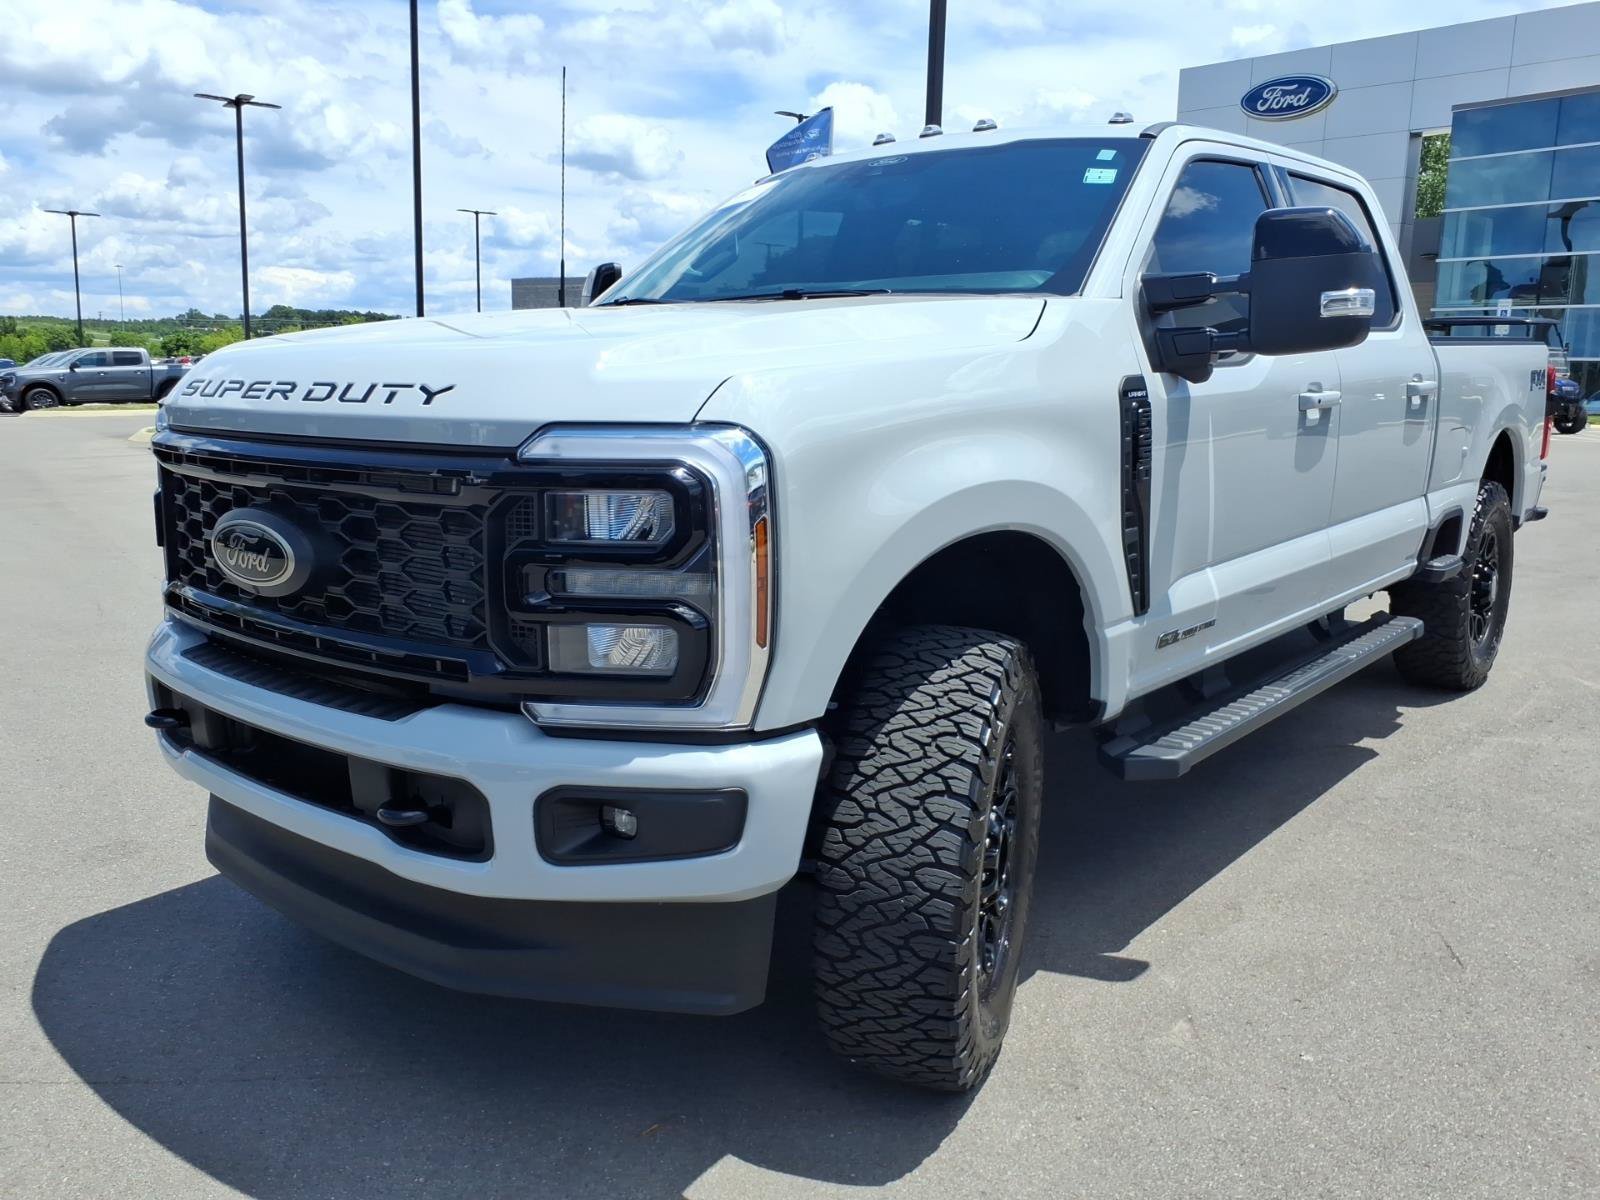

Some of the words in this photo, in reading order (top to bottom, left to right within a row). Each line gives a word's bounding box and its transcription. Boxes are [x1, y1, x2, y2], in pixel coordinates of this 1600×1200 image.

[1256, 83, 1311, 111] Ford
[181, 379, 298, 401] SUPER
[301, 382, 456, 406] DUTY
[227, 532, 271, 573] Ford
